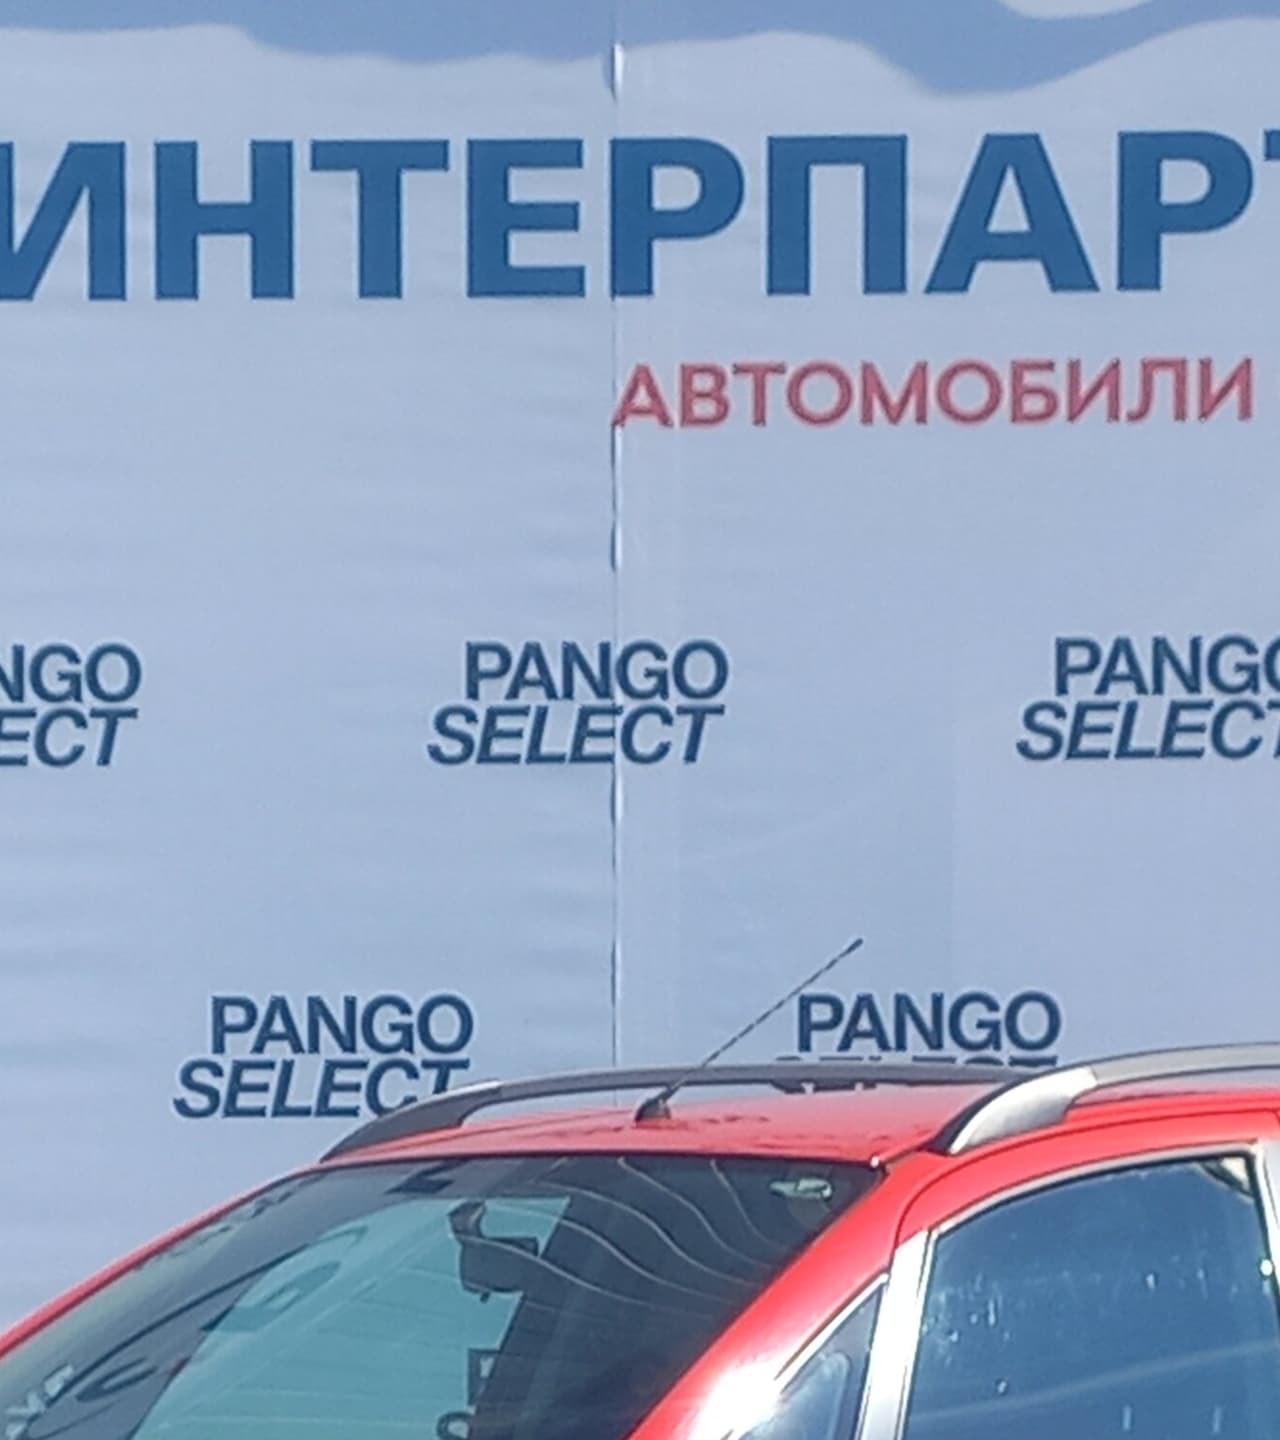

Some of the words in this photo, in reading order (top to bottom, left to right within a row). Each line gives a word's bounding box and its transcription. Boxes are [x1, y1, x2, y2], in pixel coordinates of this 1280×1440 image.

[612, 357, 1253, 429] АВТОМОБИЛИ
[466, 640, 729, 702] PANGO
[427, 703, 726, 767] SELECT
[212, 994, 474, 1056] PANGO
[798, 990, 1062, 1053] PANGO
[173, 1057, 471, 1119] SELECT
